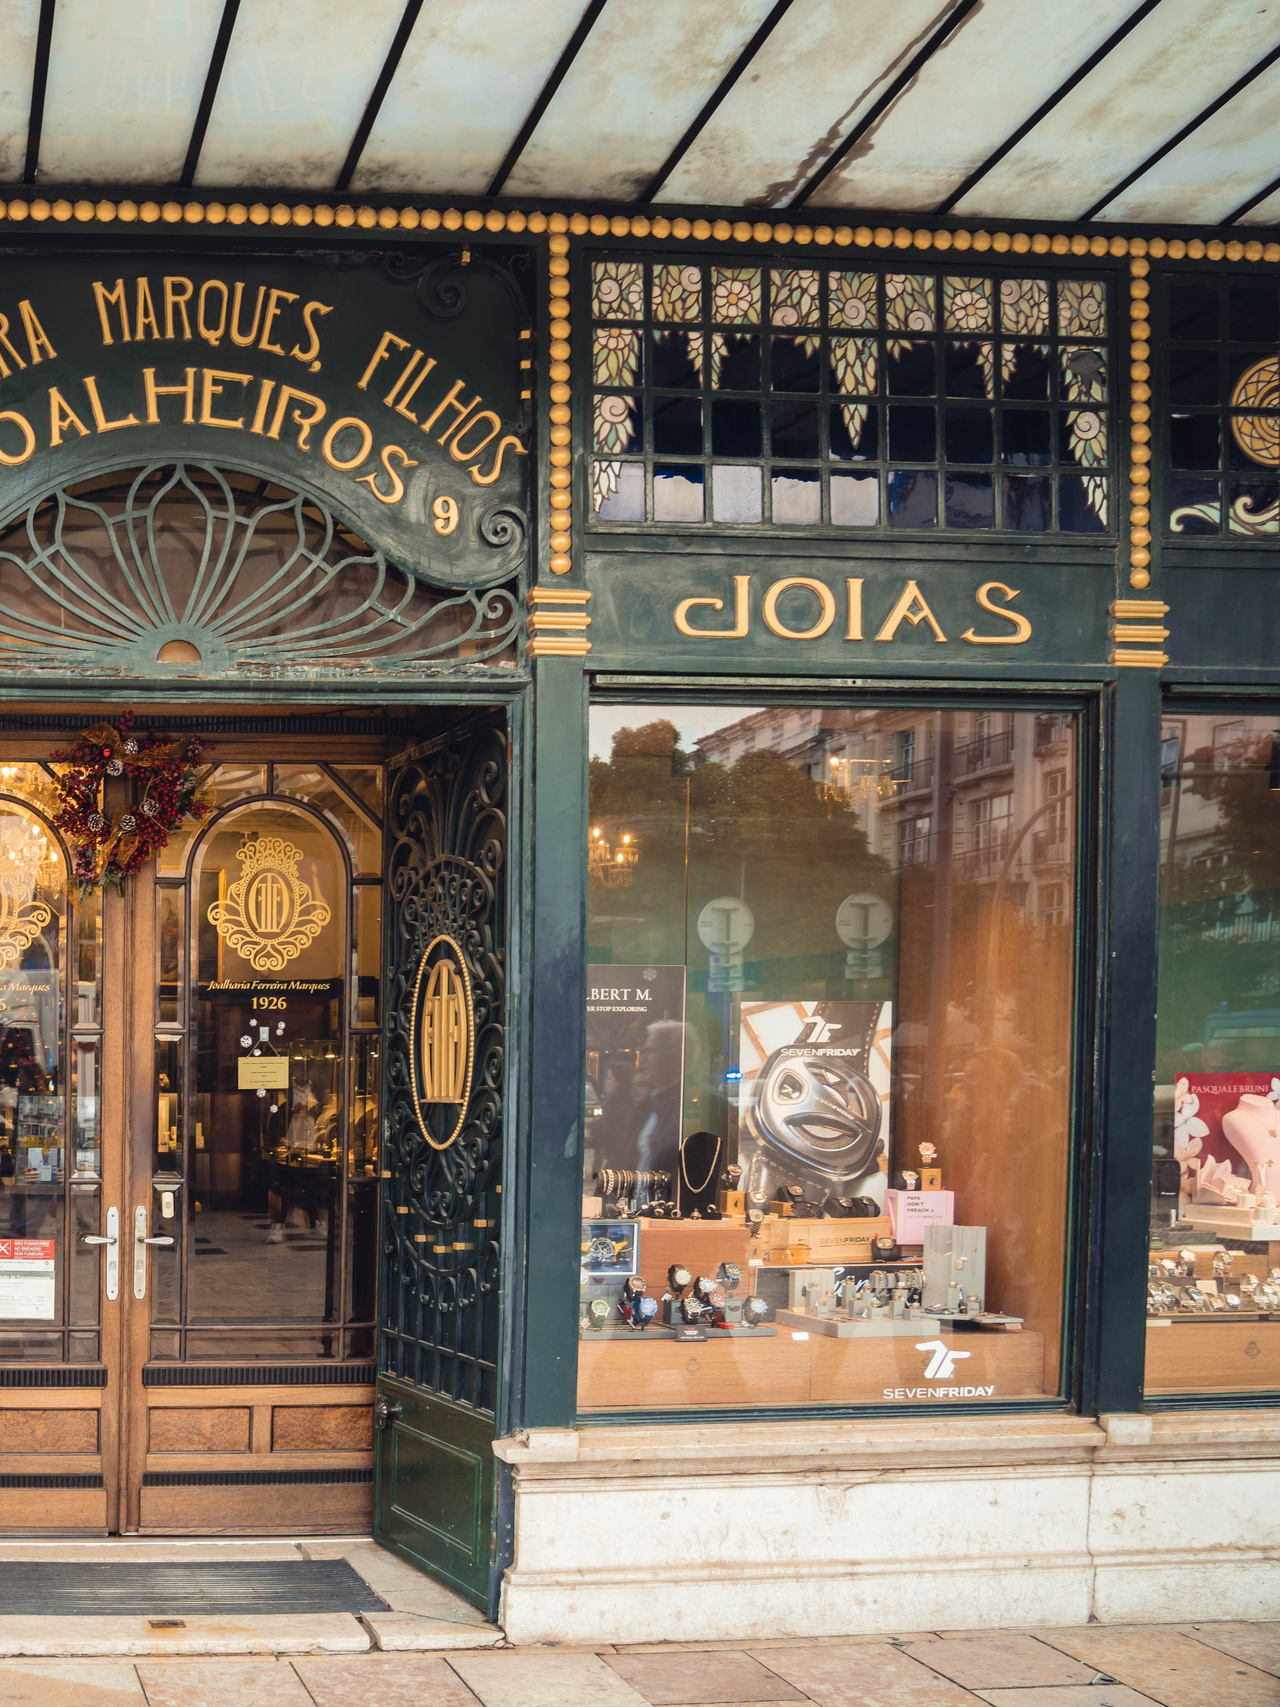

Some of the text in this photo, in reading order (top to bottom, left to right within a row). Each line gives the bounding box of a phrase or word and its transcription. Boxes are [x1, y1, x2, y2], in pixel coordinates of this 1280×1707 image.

[91, 276, 335, 372] MARQUES,
[357, 331, 529, 487] FILHOS
[431, 495, 460, 537] 9
[673, 574, 1033, 645] JOIAS
[8, 982, 51, 995] Marques
[206, 979, 331, 993] Joalharia Ferreira Marques
[635, 988, 653, 1000] M.
[251, 997, 287, 1009] 1926
[882, 1384, 996, 1400] SEVENFRIDAY
